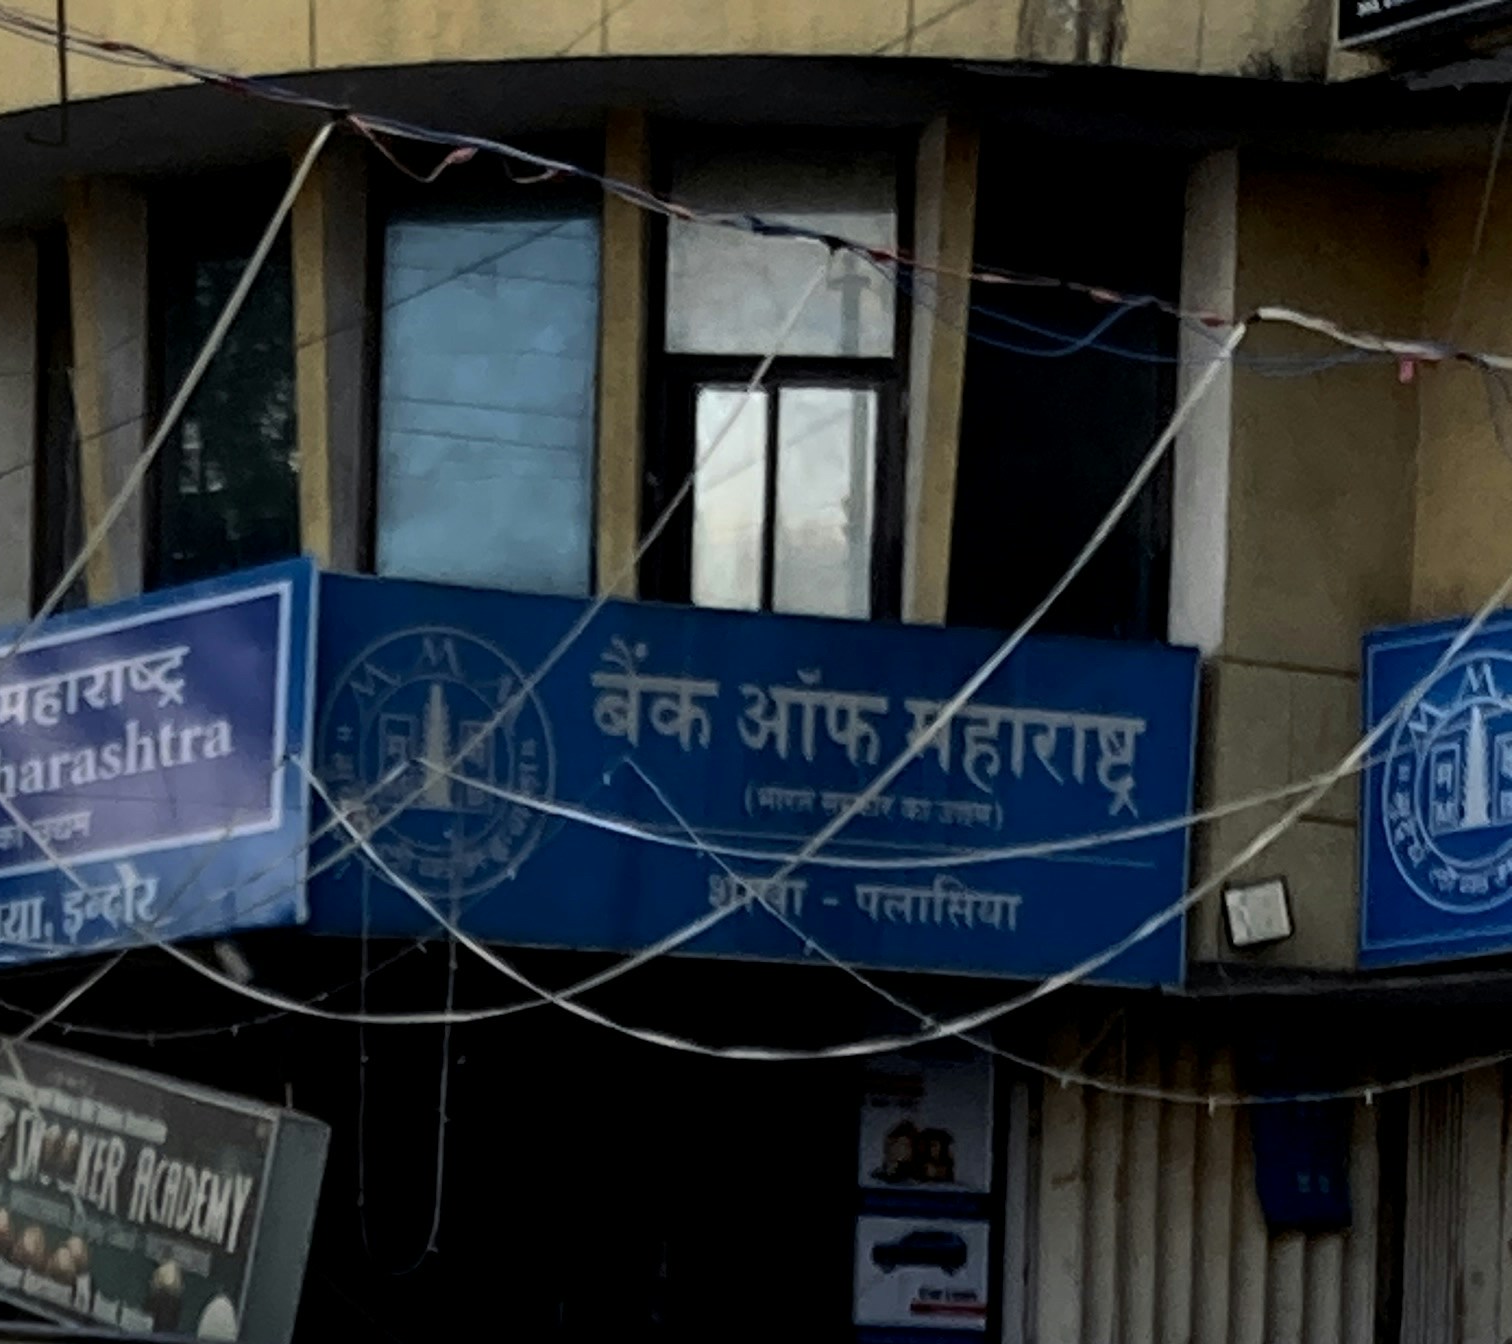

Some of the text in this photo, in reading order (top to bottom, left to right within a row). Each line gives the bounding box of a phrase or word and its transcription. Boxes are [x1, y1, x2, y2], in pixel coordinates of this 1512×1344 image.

[591, 634, 1147, 819] बैंक ऑफ महाराष्ट्र
[854, 872, 1024, 932] पलासिया
[127, 1146, 254, 1254] ACADEMY
